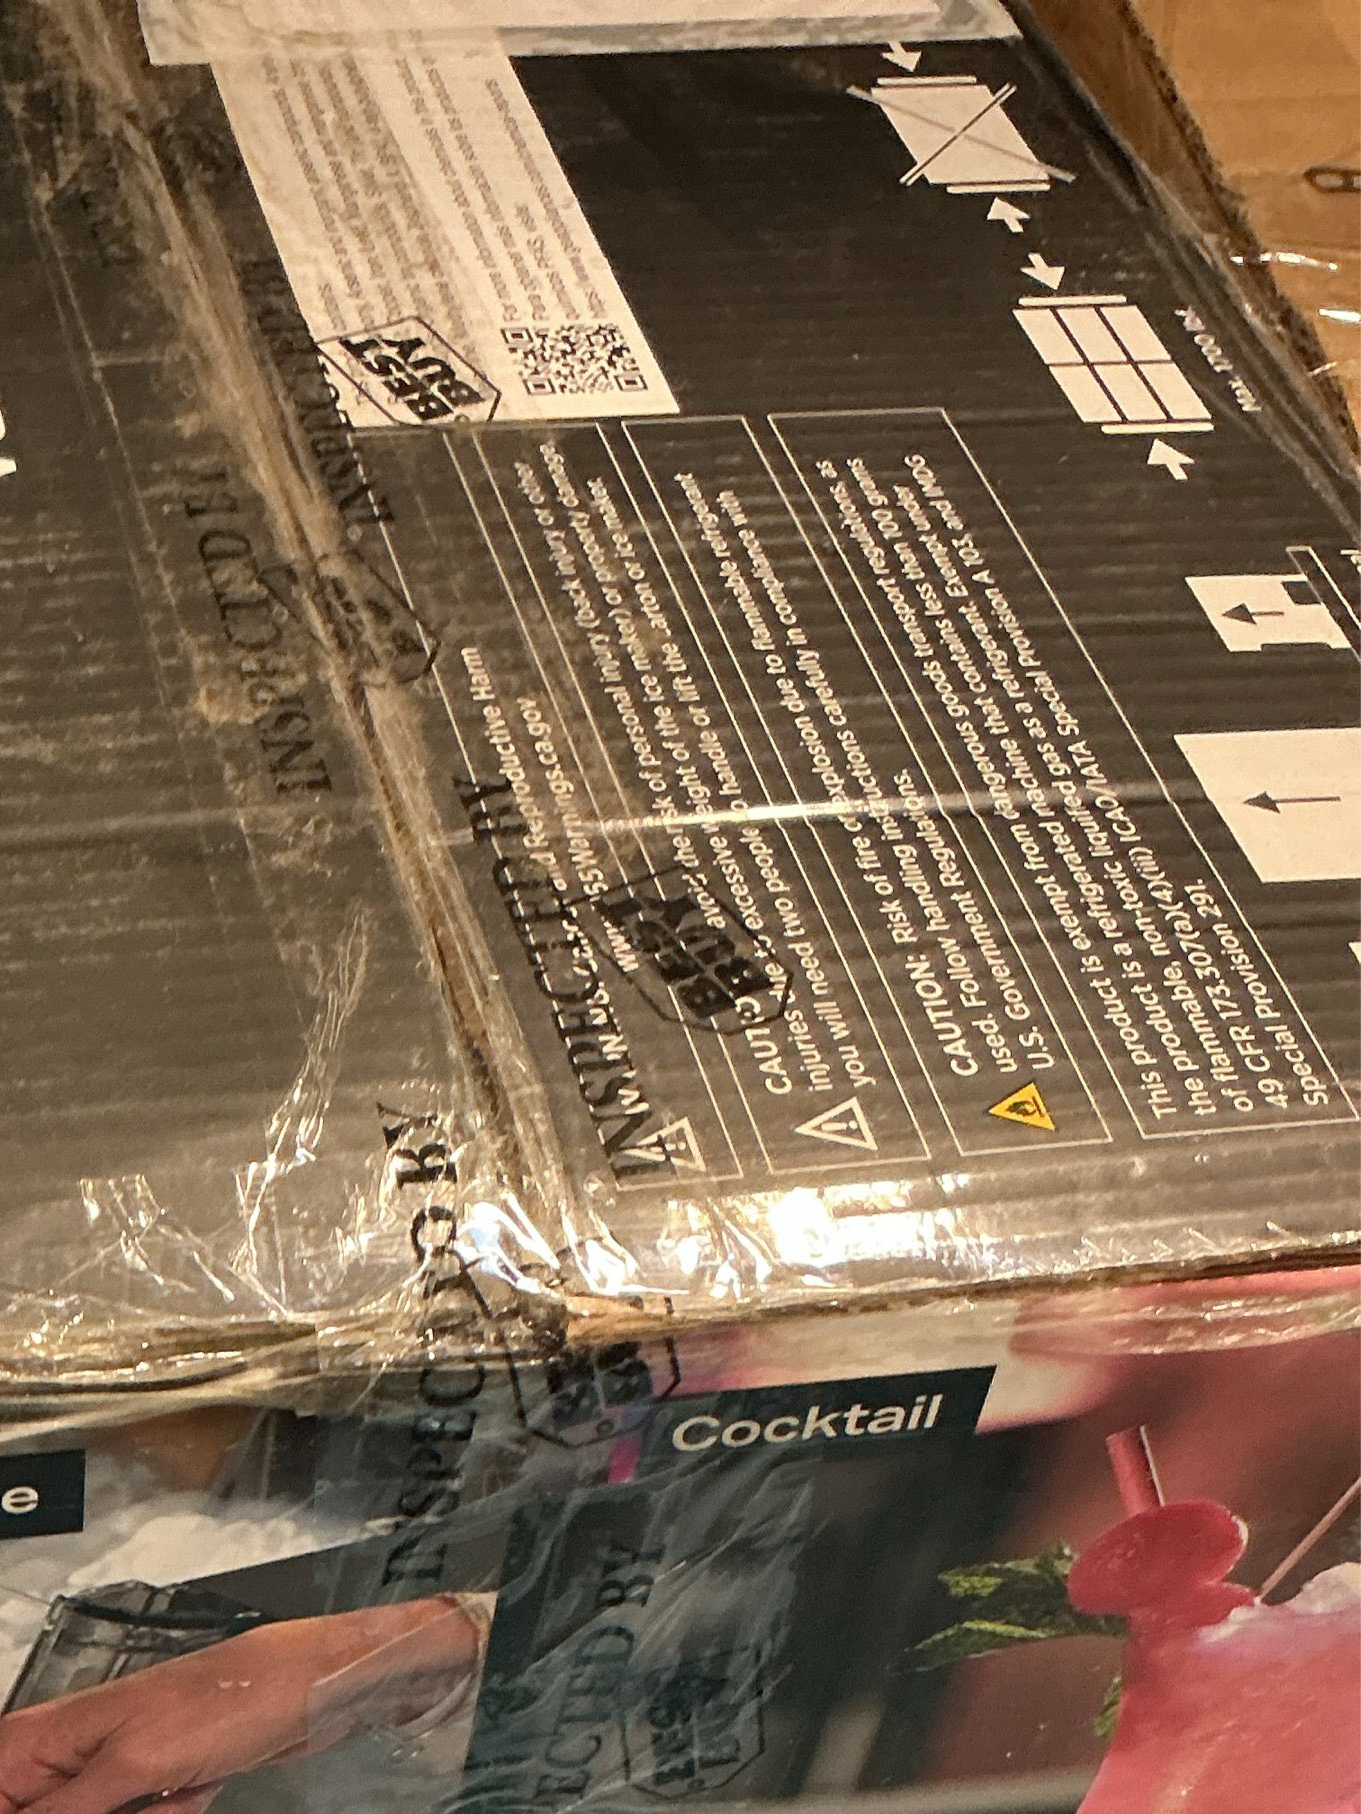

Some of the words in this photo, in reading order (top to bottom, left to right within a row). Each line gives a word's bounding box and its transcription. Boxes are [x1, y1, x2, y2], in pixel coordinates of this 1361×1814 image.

[338, 337, 454, 422] BEST
[379, 334, 485, 407] BUY
[514, 461, 545, 504] other
[815, 459, 837, 478] as
[846, 457, 888, 506] grams
[904, 454, 944, 497] IMDG
[533, 507, 554, 525] or
[674, 473, 730, 557] refrigerant
[716, 490, 748, 526] with
[871, 508, 902, 539] 100
[893, 485, 930, 531] under
[929, 499, 963, 530] and
[543, 529, 575, 575] injury
[568, 510, 616, 582] property
[611, 531, 635, 557] ice
[893, 541, 925, 580] than
[918, 533, 968, 597] Exempt
[623, 560, 645, 580] or
[738, 529, 796, 624] compliance
[971, 569, 994, 584] A
[561, 578, 600, 628] (back
[601, 585, 622, 605] or
[719, 560, 774, 650] flammable
[876, 577, 933, 657] transport
[915, 582, 945, 615] less
[608, 608, 651, 670] maker)
[785, 627, 807, 645] in
[984, 587, 1040, 666] Provision
[460, 647, 495, 700] Harm
[587, 632, 621, 682] injury
[661, 642, 686, 672] the
[764, 653, 786, 674] to
[935, 618, 986, 693] contains
[640, 674, 664, 701] ice
[672, 675, 700, 701] lift
[776, 677, 805, 712] due
[796, 649, 846, 725] carefully
[922, 660, 969, 717] goods
[1014, 701, 1033, 713] a
[1025, 670, 1079, 735] Special
[604, 685, 661, 766] personal
[653, 705, 679, 736] the
[688, 705, 710, 726] or
[973, 696, 1009, 734] that
[1022, 716, 1046, 738] as
[661, 740, 690, 761] of
[698, 730, 741, 795] handle
[955, 721, 1019, 819] dangerous
[1036, 742, 1071, 776] gas
[483, 705, 549, 847] Reproductive
[638, 770, 667, 792] of
[1000, 738, 1054, 816] machine
[1068, 740, 1140, 841] ICAO/IATA
[739, 827, 790, 892] people
[852, 836, 881, 869] fire
[1010, 823, 1048, 870] from
[709, 836, 763, 929] excessive
[862, 873, 893, 895] of
[893, 844, 949, 931] handling
[1039, 821, 1121, 937] refrigerated
[1184, 878, 1222, 918] 291.
[774, 897, 805, 937] two
[879, 899, 917, 943] Risk
[1035, 875, 1091, 950] exempt
[1103, 861, 1170, 955] non-toxic
[951, 891, 1029, 1020] Government
[1112, 942, 1132, 956] a
[1129, 846, 1240, 1018] 173.307(a)(4)(iii)
[787, 941, 828, 995] need
[937, 937, 986, 1007] Follow
[1080, 954, 1104, 973] is
[1121, 960, 1145, 978] is
[1212, 923, 1280, 1018] Provision
[813, 1001, 849, 1040] will
[905, 954, 977, 1075] CAUTION:
[1089, 978, 1157, 1065] product
[1131, 983, 1198, 1070] product
[1163, 961, 1237, 1081] flammable,
[784, 1009, 832, 1091] injuries
[838, 1044, 876, 1087] you
[971, 1013, 1017, 1072] used.
[1018, 1025, 1054, 1069] U.S.
[1228, 1025, 1270, 1072] CFR
[1264, 1024, 1328, 1105] Special
[1140, 1071, 1176, 1119] This
[1184, 1077, 1216, 1115] the
[1220, 1087, 1253, 1112] of
[1257, 1078, 1288, 1109] 49
[672, 1394, 943, 1451] Cocktail
